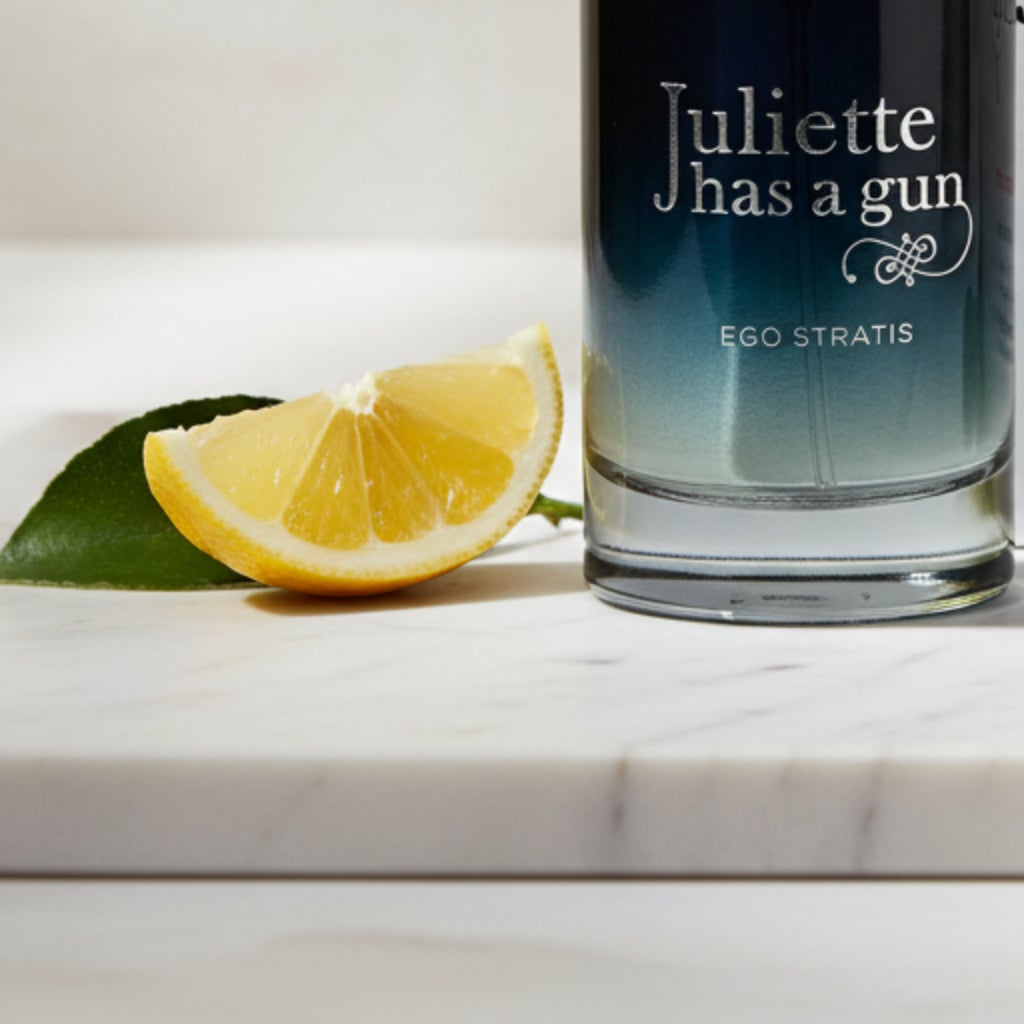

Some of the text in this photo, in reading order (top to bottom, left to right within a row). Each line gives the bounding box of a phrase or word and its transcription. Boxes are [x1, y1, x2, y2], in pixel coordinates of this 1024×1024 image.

[654, 82, 936, 212] Juliette
[690, 162, 793, 216] has
[811, 180, 846, 216] a
[860, 172, 965, 227] gun
[720, 322, 914, 348] EGO STRATIS
